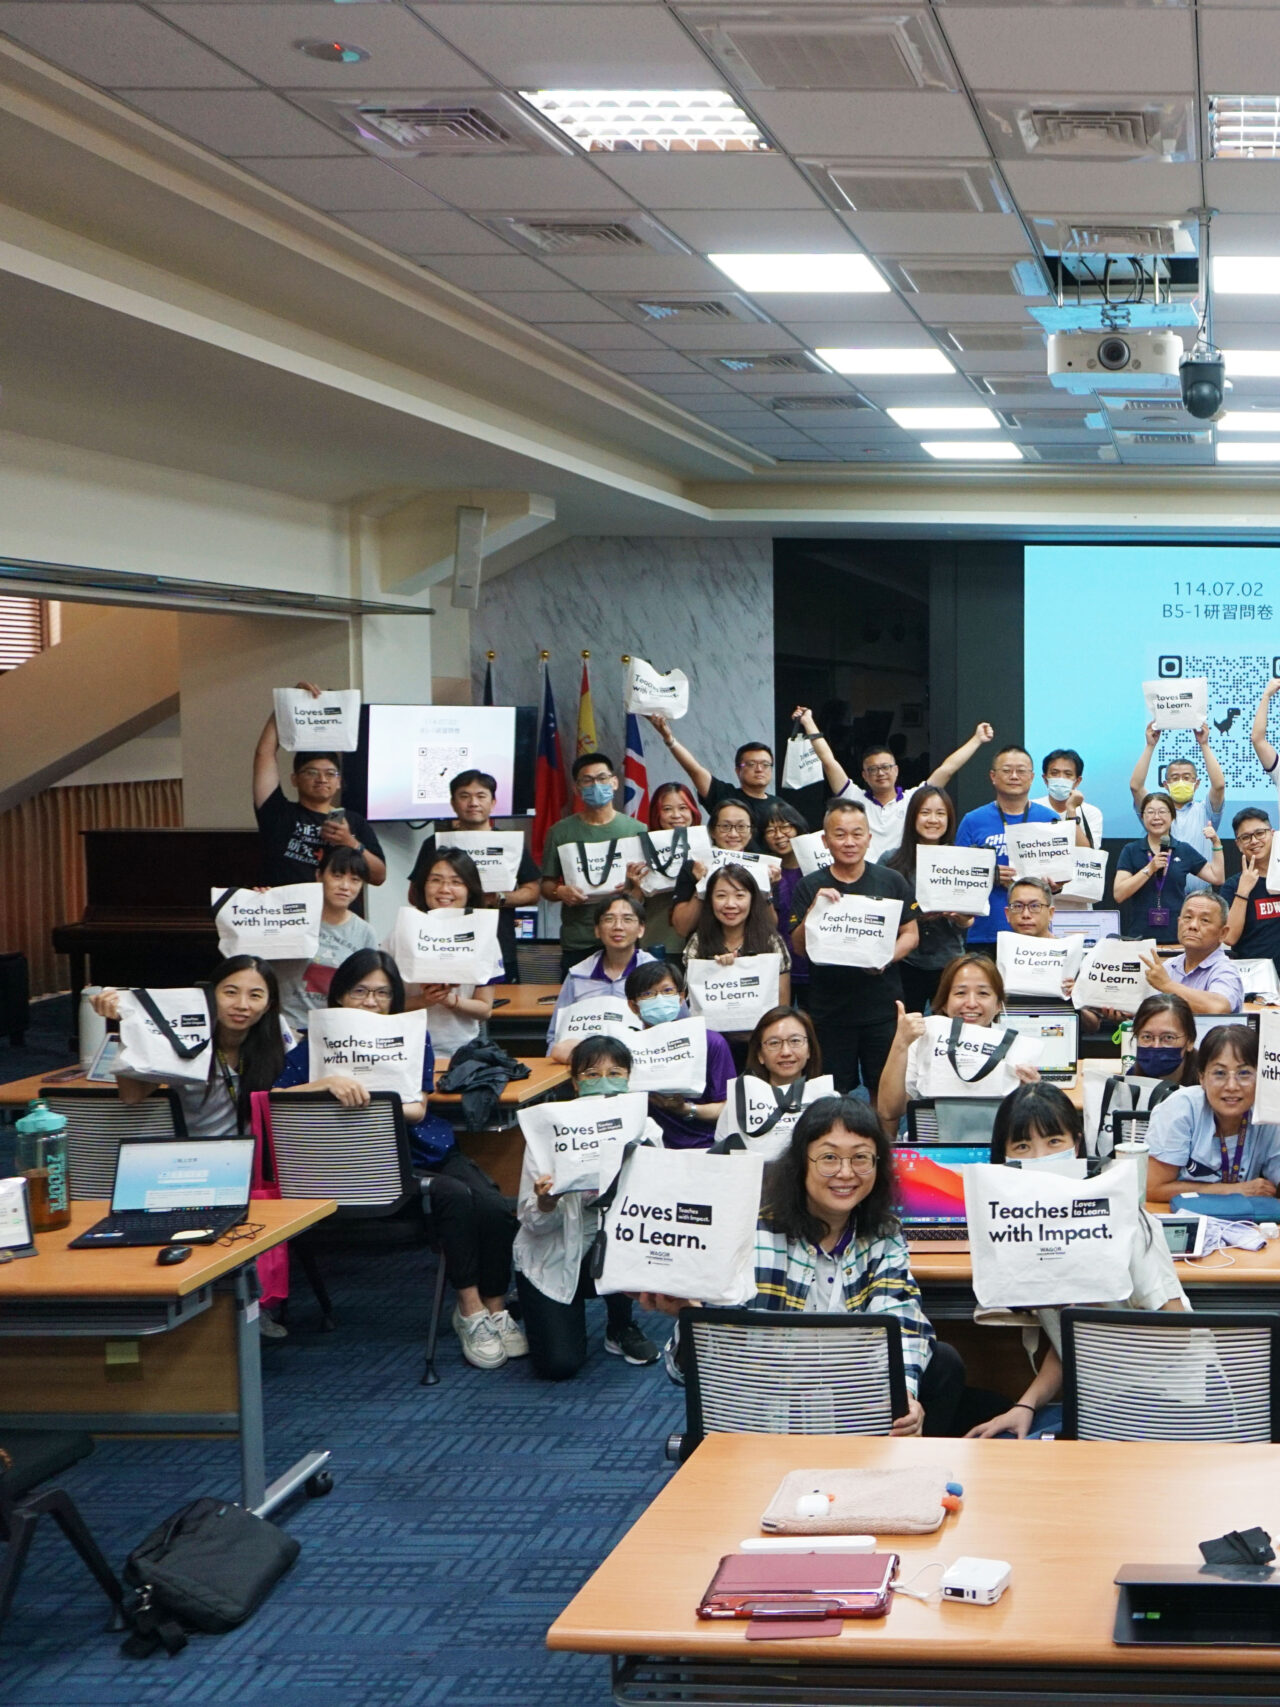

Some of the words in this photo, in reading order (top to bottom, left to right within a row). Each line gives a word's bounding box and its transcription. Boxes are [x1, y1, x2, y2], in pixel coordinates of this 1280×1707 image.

[1174, 582, 1264, 597] 114.07.02
[1163, 603, 1274, 620] B5-1研習問卷
[295, 706, 323, 716] Loves
[295, 717, 305, 725] to
[308, 716, 342, 725] Learn.
[1016, 840, 1051, 849] Teaches
[712, 850, 741, 859] Loves
[1019, 850, 1037, 859] with
[1039, 849, 1070, 859] Impact.
[475, 858, 502, 866] earn.
[932, 865, 970, 876] Teaches
[930, 876, 952, 885] with
[954, 877, 989, 889] Impact.
[232, 905, 281, 915] Teaches
[232, 917, 261, 927] with
[264, 917, 310, 929] Impact.
[824, 912, 862, 923] Teaches
[419, 929, 452, 943] Loves
[820, 924, 842, 932] with
[845, 925, 885, 938] Impact.
[418, 942, 429, 952] to
[432, 943, 474, 952] Learn.
[1016, 947, 1047, 957] Loves
[1028, 958, 1064, 967] Learn.
[1092, 960, 1120, 972] Loves
[1089, 972, 1098, 981] to
[1101, 972, 1138, 984] Learn.
[704, 980, 738, 990] Loves
[705, 993, 718, 1001] to
[720, 991, 759, 1000] Learn.
[570, 1014, 602, 1023] Loves
[568, 1023, 579, 1032] to
[323, 1035, 373, 1049] Teaches
[631, 1046, 666, 1056] aches
[323, 1051, 348, 1064] with
[352, 1051, 408, 1065] Impact.
[650, 1051, 695, 1064] Impact.
[750, 1115, 763, 1125] to
[553, 1124, 594, 1137] Loves
[555, 1141, 568, 1152] to
[620, 1196, 673, 1221] Loves
[988, 1200, 1069, 1219] Teaches
[1074, 1200, 1096, 1208] Loves
[1083, 1208, 1109, 1216] Learn.
[615, 1222, 634, 1242] to
[639, 1222, 706, 1251] Learn.
[988, 1223, 1033, 1242] with
[1039, 1223, 1113, 1245] Impact.
